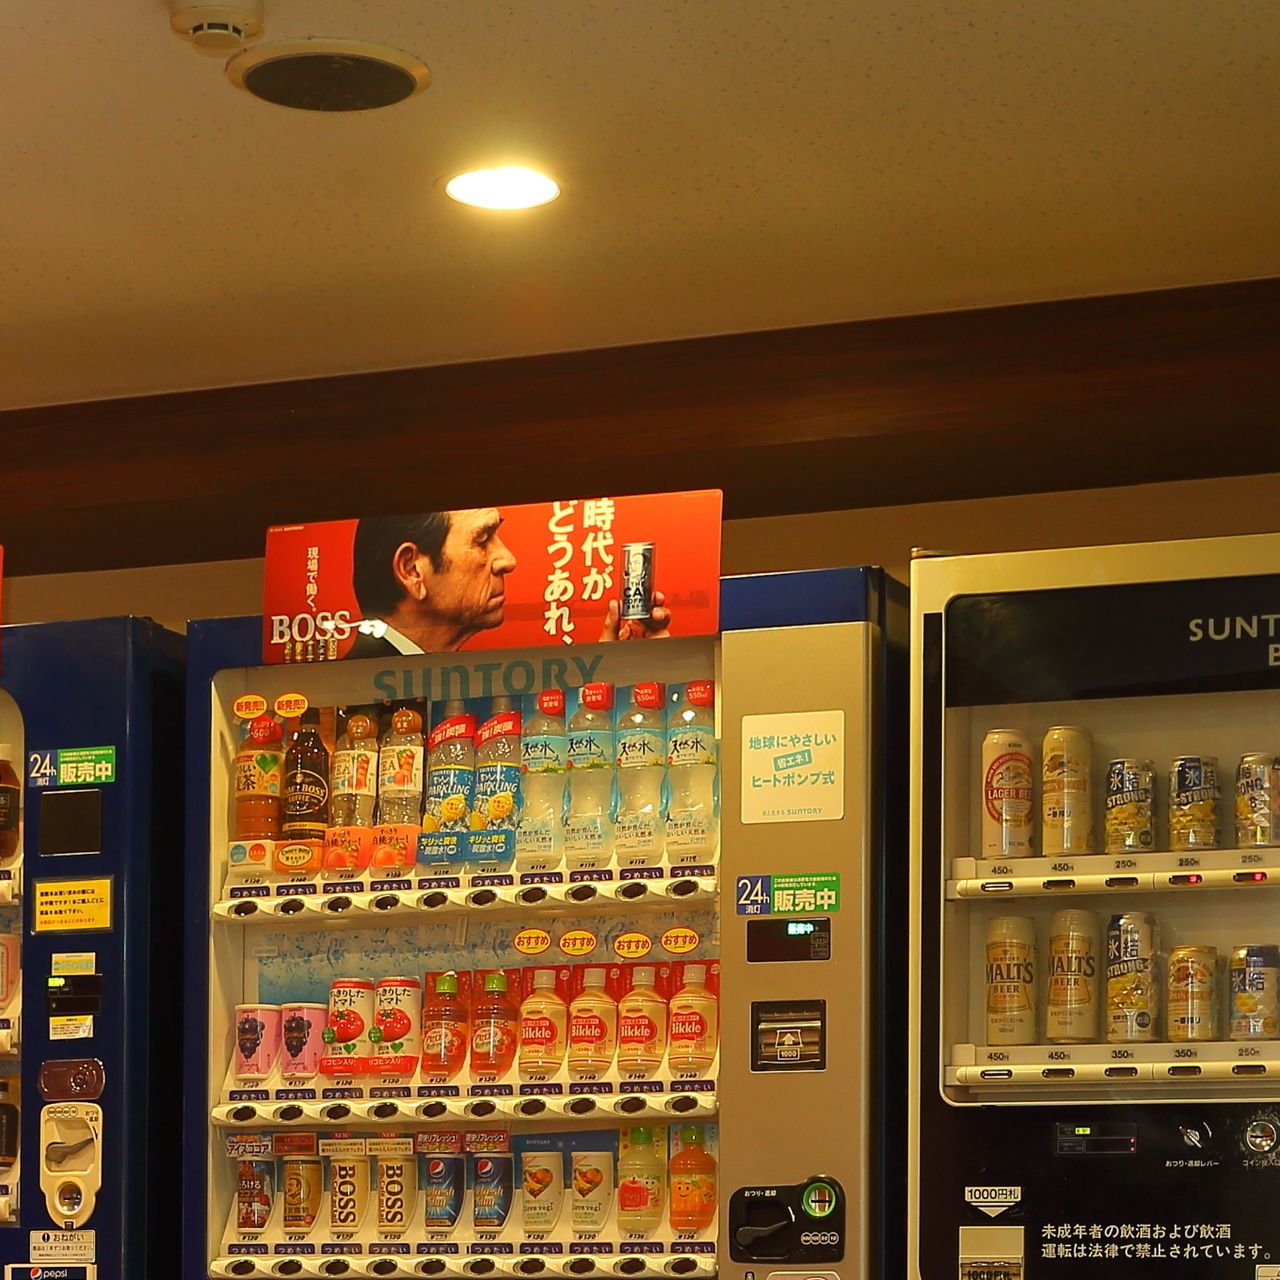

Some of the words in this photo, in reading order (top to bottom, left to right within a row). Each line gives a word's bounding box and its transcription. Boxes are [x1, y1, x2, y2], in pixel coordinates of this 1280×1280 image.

[581, 497, 615, 601] 時代が
[544, 500, 579, 645] どうあれ、
[305, 547, 319, 612] 現場で働く。
[271, 611, 352, 644] BOSS
[749, 732, 837, 750] 地球にやさしい
[29, 753, 56, 778] 24h
[60, 761, 112, 783] 販売中
[752, 771, 835, 788] ヒートポンプ式
[988, 789, 1017, 800] LAGER
[1106, 789, 1146, 807] STRONG
[787, 807, 822, 816] SUNTORY
[1179, 858, 1200, 867] 250円
[1241, 855, 1263, 863] 250円
[1052, 863, 1074, 872] 450円
[1115, 860, 1136, 869] 250円
[991, 866, 1013, 875] 450円
[738, 879, 770, 905] 24h
[774, 889, 836, 912] 販売中
[745, 905, 761, 914] 消灯
[515, 935, 549, 947] おすすめ
[561, 936, 595, 947] おすすめ
[616, 939, 650, 950] おすすめ
[663, 935, 696, 945] おすすめ
[1054, 978, 1080, 986] BEER
[1232, 971, 1265, 992] 氷結
[993, 985, 1020, 994] BEER
[333, 997, 356, 1006] トマト
[378, 997, 402, 1005] トマト
[781, 1050, 797, 1058] 1000
[987, 1052, 1009, 1061] 450円
[1048, 1051, 1070, 1060] 450円
[1111, 1050, 1134, 1059] 350円
[1174, 1049, 1197, 1058] 350円
[1238, 1048, 1260, 1056] 250円
[473, 1087, 511, 1095] つめたい
[522, 1086, 559, 1094] つめたい
[573, 1085, 609, 1093] つめたい
[623, 1084, 660, 1092] つめたい
[673, 1082, 711, 1091] つめたい
[232, 1092, 266, 1100] つめたい
[325, 1090, 361, 1098] つめたい
[372, 1089, 408, 1097] つめたい
[421, 1088, 457, 1096] つめたい
[228, 1143, 269, 1154] アイスココア
[1165, 1160, 1220, 1168] おつり・返却レバー
[337, 1165, 356, 1224] BOSS
[385, 1164, 404, 1223] BOSS
[967, 1188, 1019, 1201] 1000円札
[1041, 1223, 1231, 1240] 未成年者の飲酒および飲酒
[53, 1234, 84, 1242] おねがい
[277, 1246, 313, 1254] つめたい
[1041, 1243, 1271, 1260] 運転は法律で禁止されています。
[43, 1269, 68, 1279] pepsi
